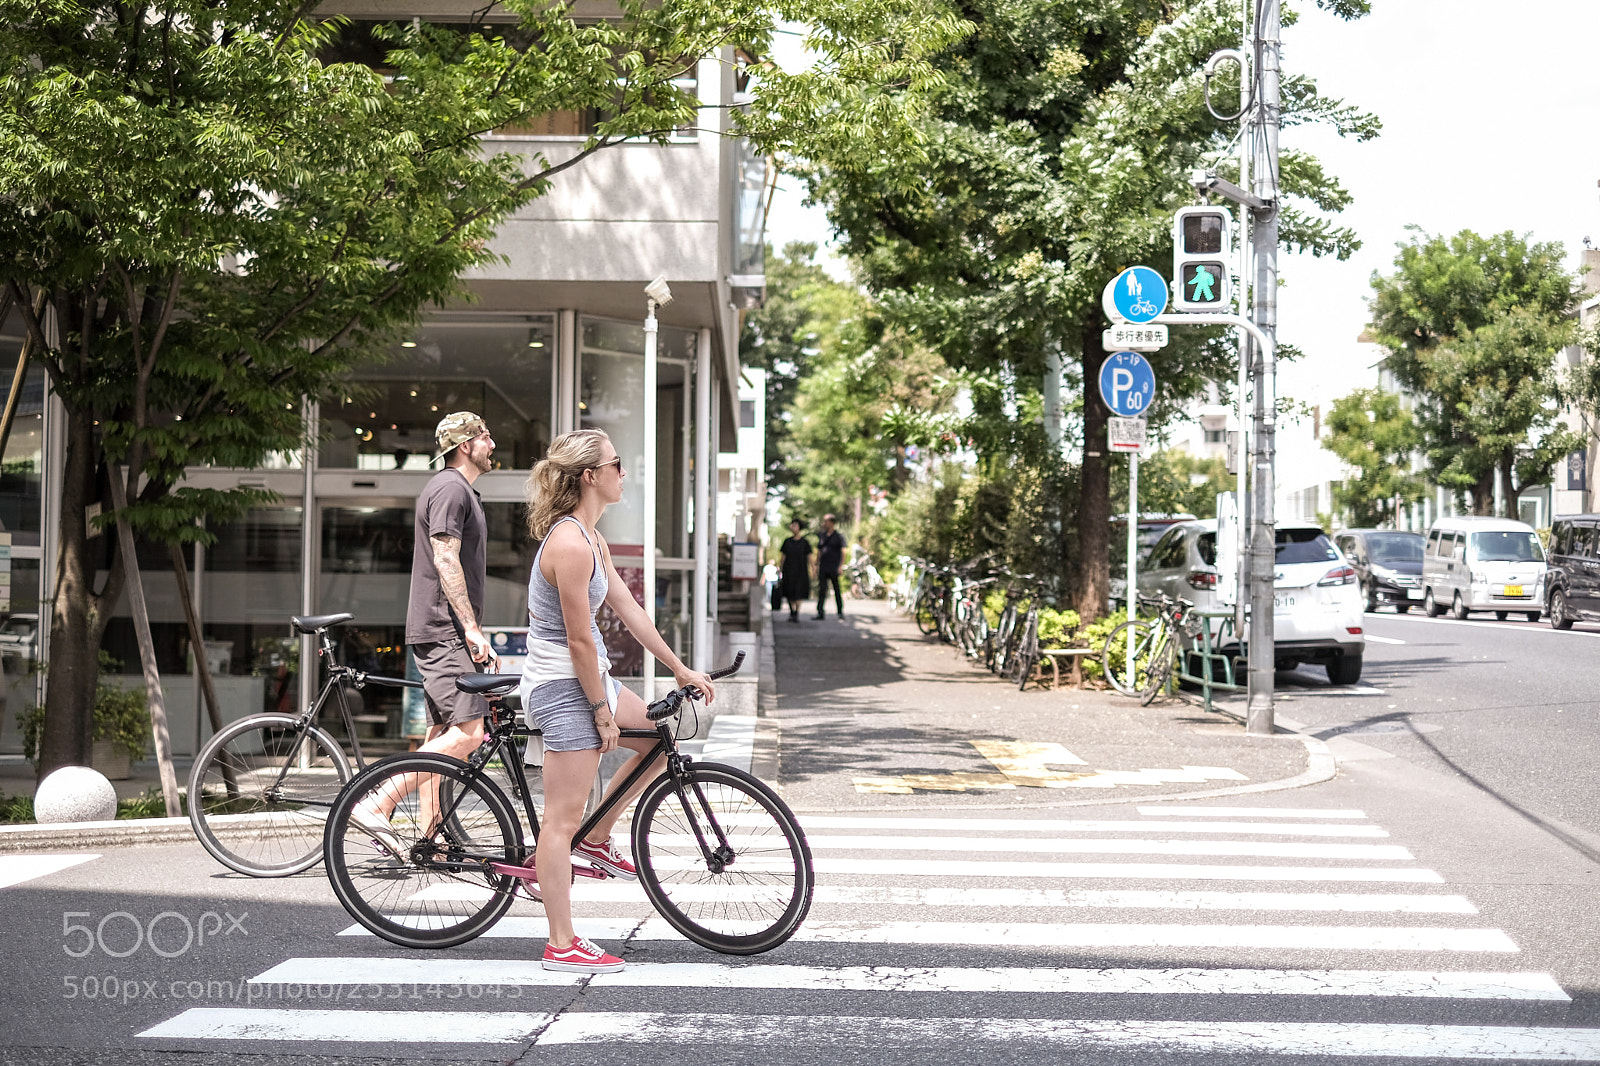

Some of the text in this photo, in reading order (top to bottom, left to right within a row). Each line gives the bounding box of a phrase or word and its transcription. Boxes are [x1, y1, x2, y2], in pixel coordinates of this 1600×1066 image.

[1116, 330, 1164, 342] 歩行者優先
[1116, 354, 1140, 366] 9-19
[1112, 368, 1134, 409] P
[1126, 391, 1142, 410] 60
